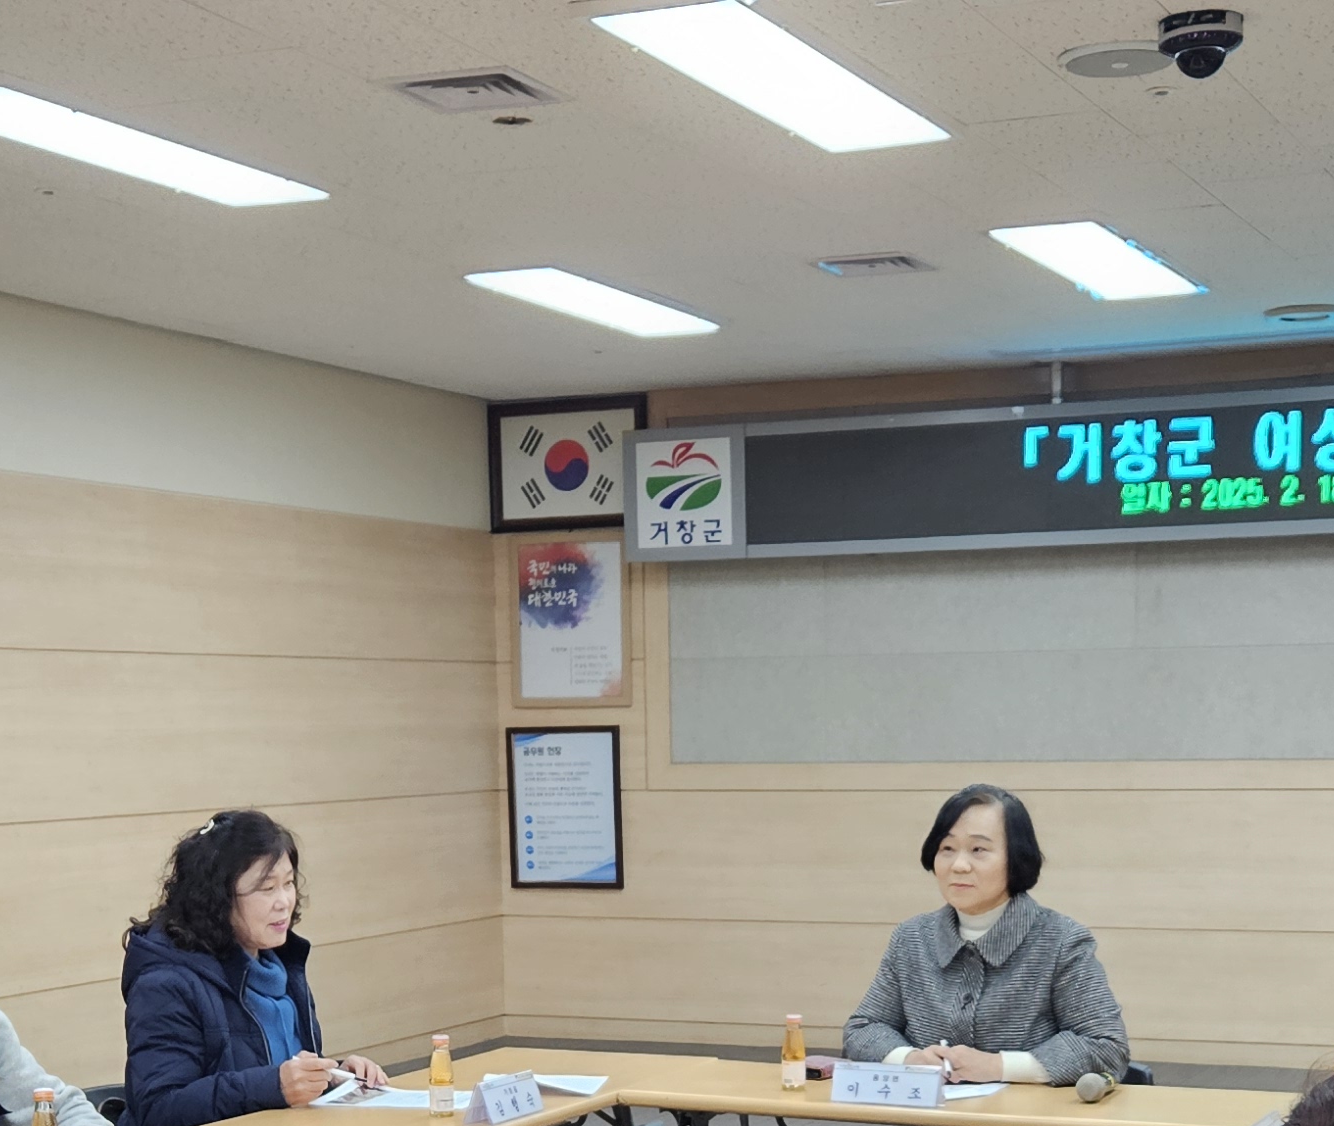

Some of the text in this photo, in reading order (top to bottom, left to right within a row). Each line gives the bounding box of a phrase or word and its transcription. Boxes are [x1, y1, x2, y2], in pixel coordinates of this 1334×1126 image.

[1121, 478, 1172, 515] 일자
[1201, 477, 1269, 510] 2025.
[1279, 474, 1305, 506] 2.
[650, 519, 722, 545] 거창군
[528, 589, 578, 608] 대한민국
